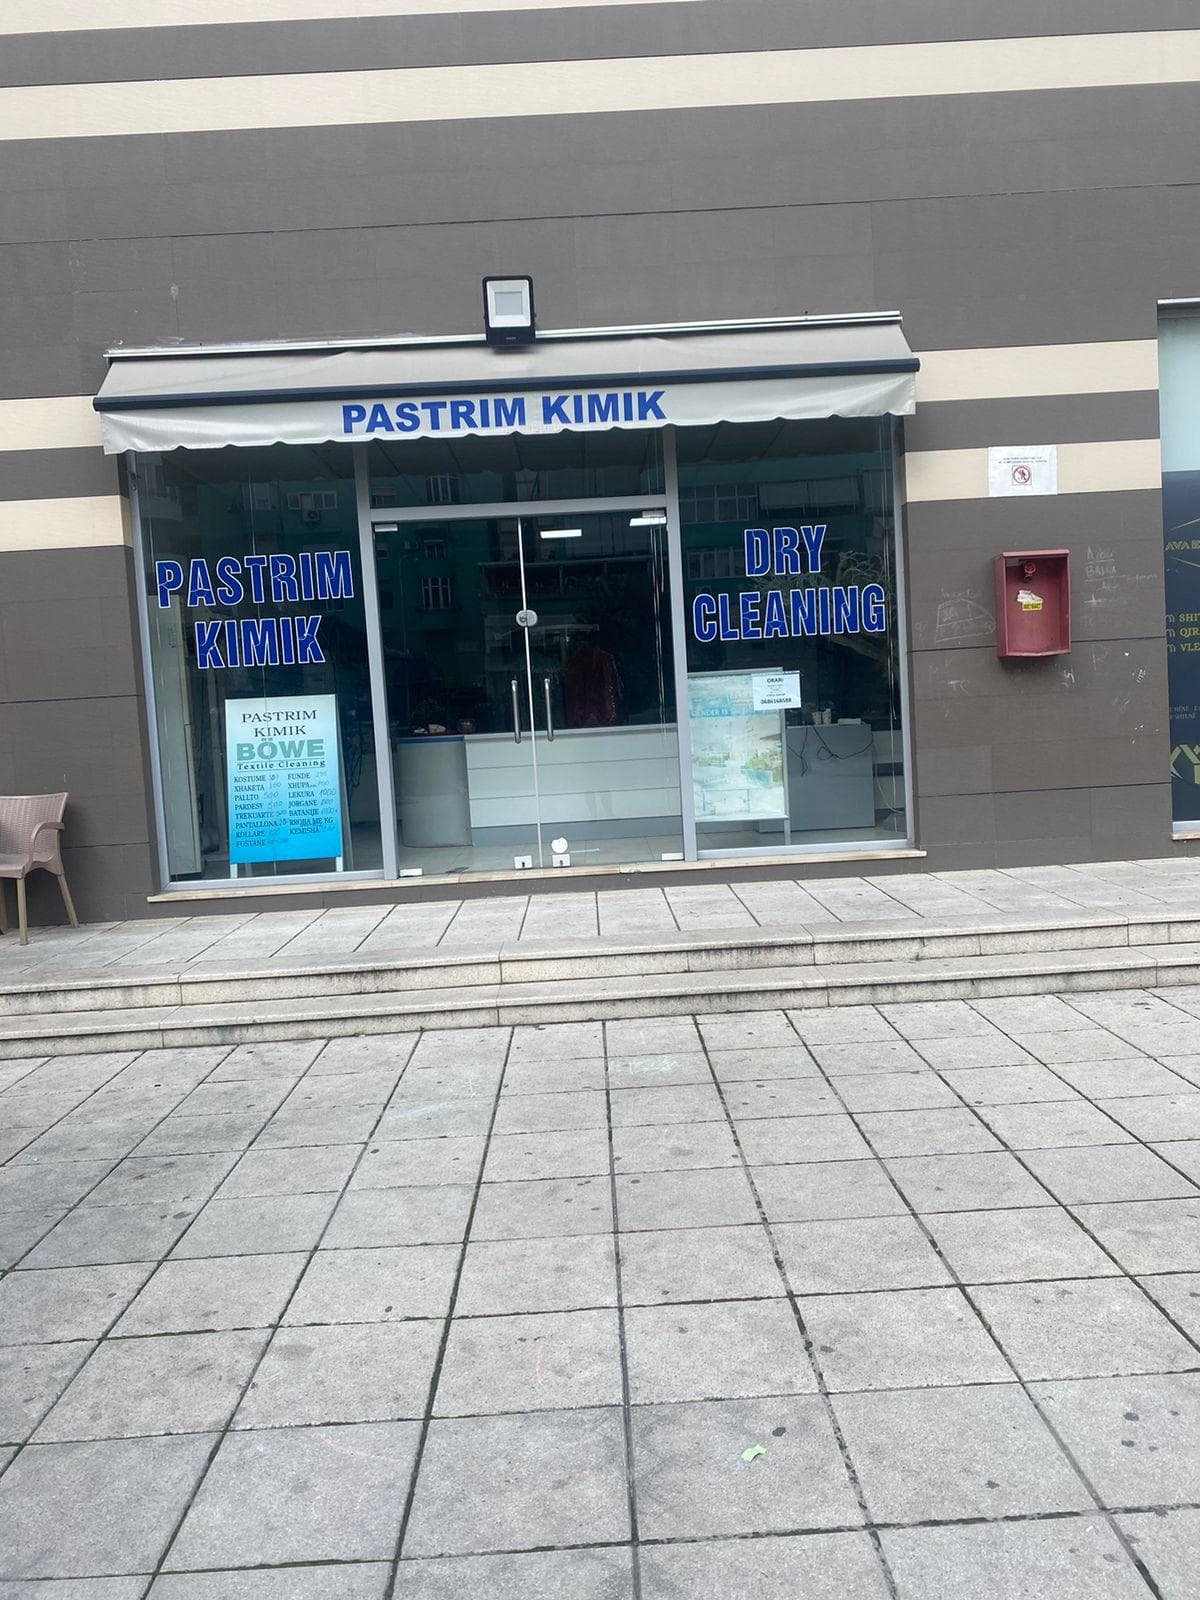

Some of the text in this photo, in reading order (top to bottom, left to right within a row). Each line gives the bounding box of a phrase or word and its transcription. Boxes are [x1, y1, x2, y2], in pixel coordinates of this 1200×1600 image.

[342, 390, 667, 434] PASTRIM KIMIK
[744, 524, 827, 577] DRY
[155, 550, 354, 609] PASTRIM
[692, 583, 887, 643] CLEANING
[194, 615, 326, 670] KIMIK
[242, 709, 318, 723] PASTRIM
[254, 725, 307, 738] KIMIK
[236, 737, 325, 761] BÖWE
[237, 760, 326, 771] Textile Cleaning
[233, 775, 266, 783] KOSTUME
[234, 784, 265, 792] XHAKETA
[288, 781, 310, 789] XHUPA
[234, 793, 259, 802] PALLTO
[288, 790, 315, 798] LEKURA
[234, 802, 264, 811] PARDESY
[288, 799, 318, 808] JORGANE
[235, 811, 275, 820] TREKUARTE
[289, 808, 320, 817] BATANIJE
[235, 820, 277, 829] PANTALLONA
[235, 829, 266, 838] KOLLARE
[235, 839, 266, 848] FUSTANE
